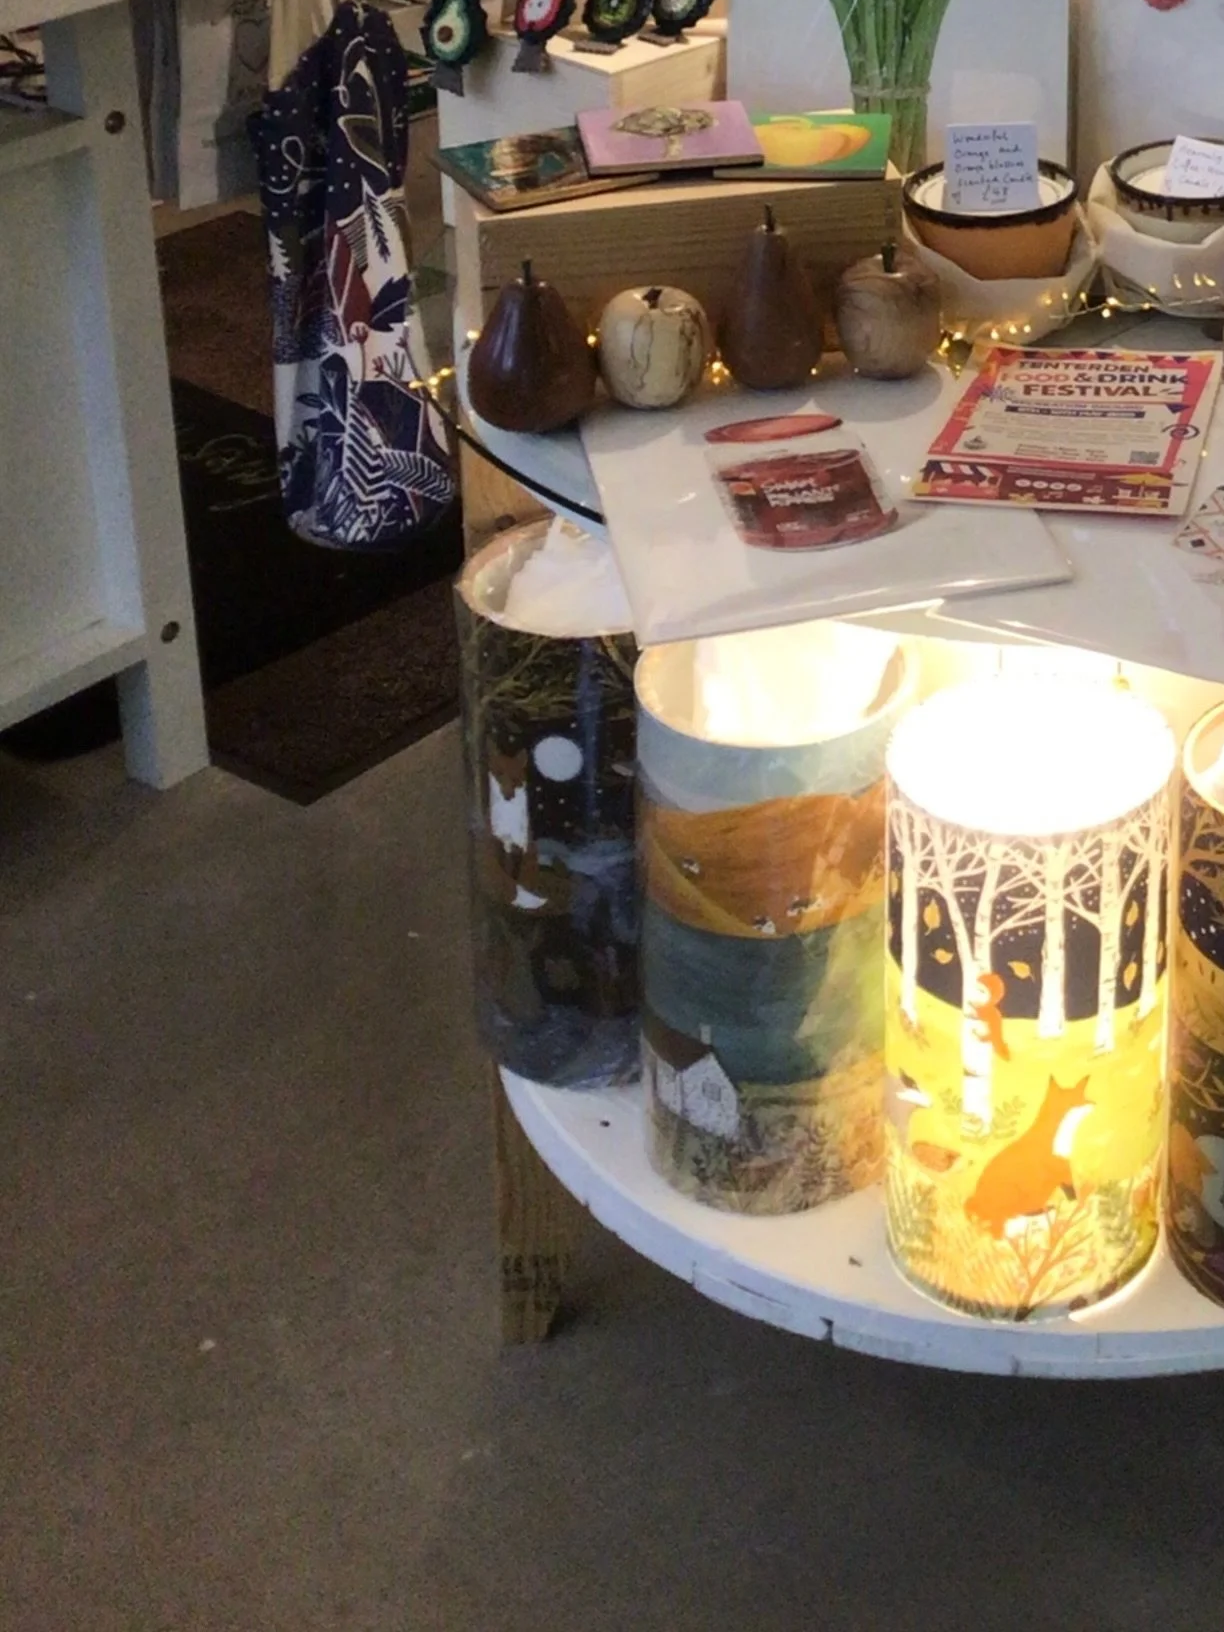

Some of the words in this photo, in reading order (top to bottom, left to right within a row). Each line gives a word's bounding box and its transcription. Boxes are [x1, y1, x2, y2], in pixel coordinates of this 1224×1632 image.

[953, 148, 990, 162] Orange
[1018, 360, 1150, 374] TENTERDEN
[1001, 372, 1069, 383] FOOD
[1073, 372, 1093, 383] &
[1097, 373, 1189, 385] DRINK
[1022, 384, 1158, 397] FESTIVAL
